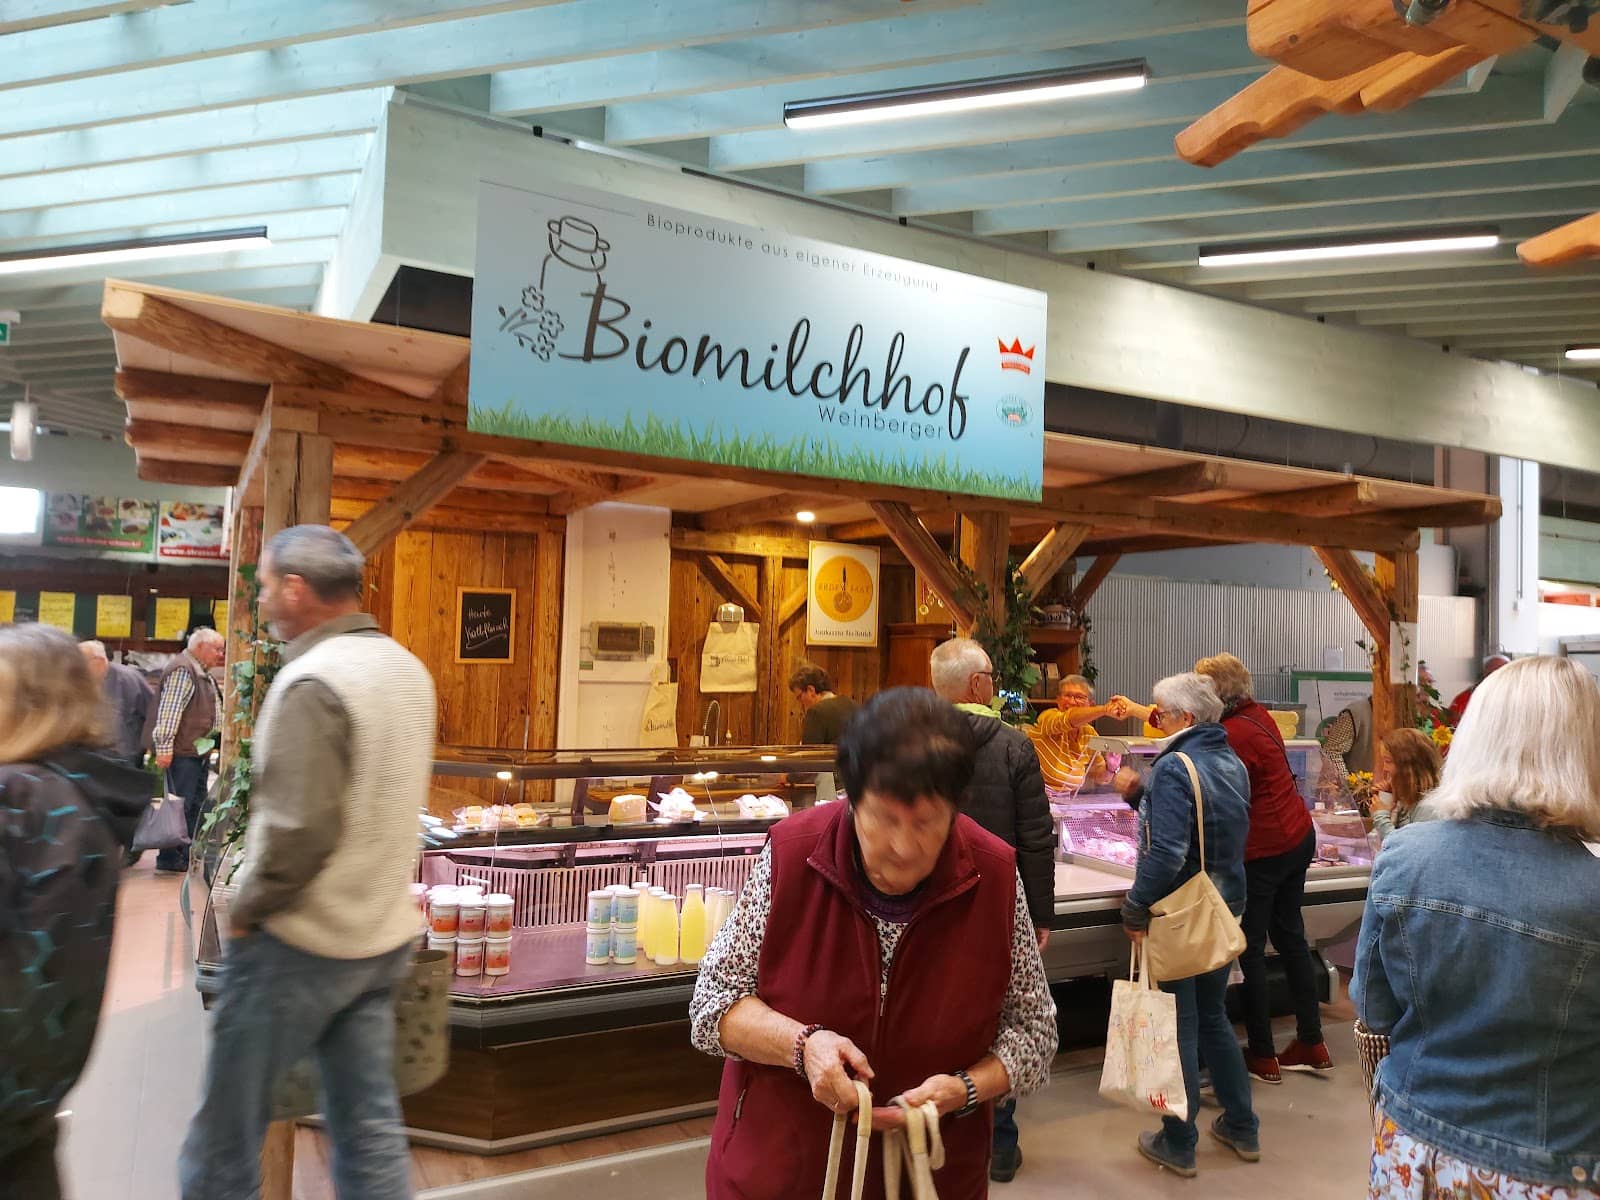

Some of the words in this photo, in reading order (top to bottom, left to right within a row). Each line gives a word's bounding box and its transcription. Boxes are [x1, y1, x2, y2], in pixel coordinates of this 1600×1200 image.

[646, 212, 753, 251] Bioprodukte
[761, 242, 789, 259] aus
[795, 251, 858, 275] eigener
[572, 283, 970, 441] Biomilchhof
[818, 402, 944, 440] Weinberger
